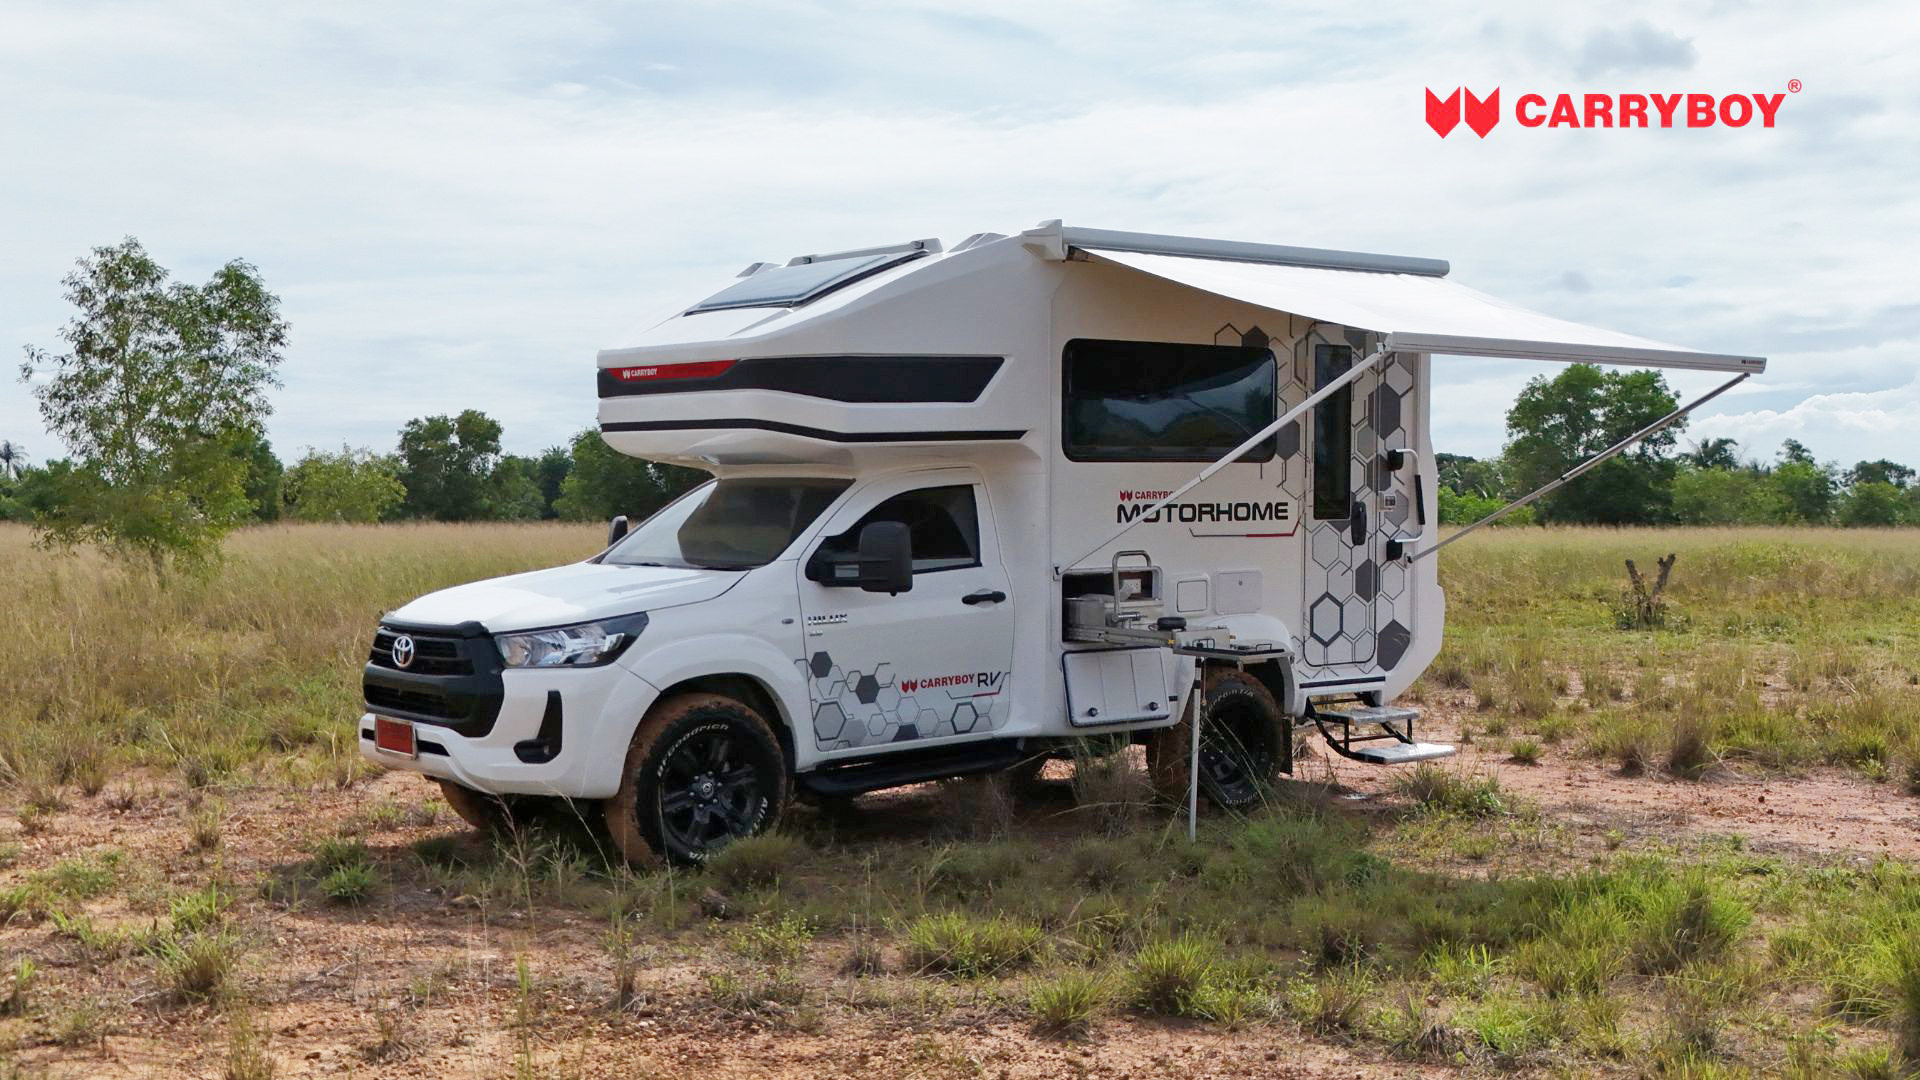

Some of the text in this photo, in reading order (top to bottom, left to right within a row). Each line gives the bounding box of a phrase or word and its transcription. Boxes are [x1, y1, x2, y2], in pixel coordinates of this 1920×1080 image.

[630, 367, 657, 377] CARRYBOY
[1135, 490, 1174, 500] CARRYB
[1116, 502, 1288, 523] MOTORHOME
[807, 613, 848, 626] HILUX
[920, 671, 1001, 689] CARRYBOY RV
